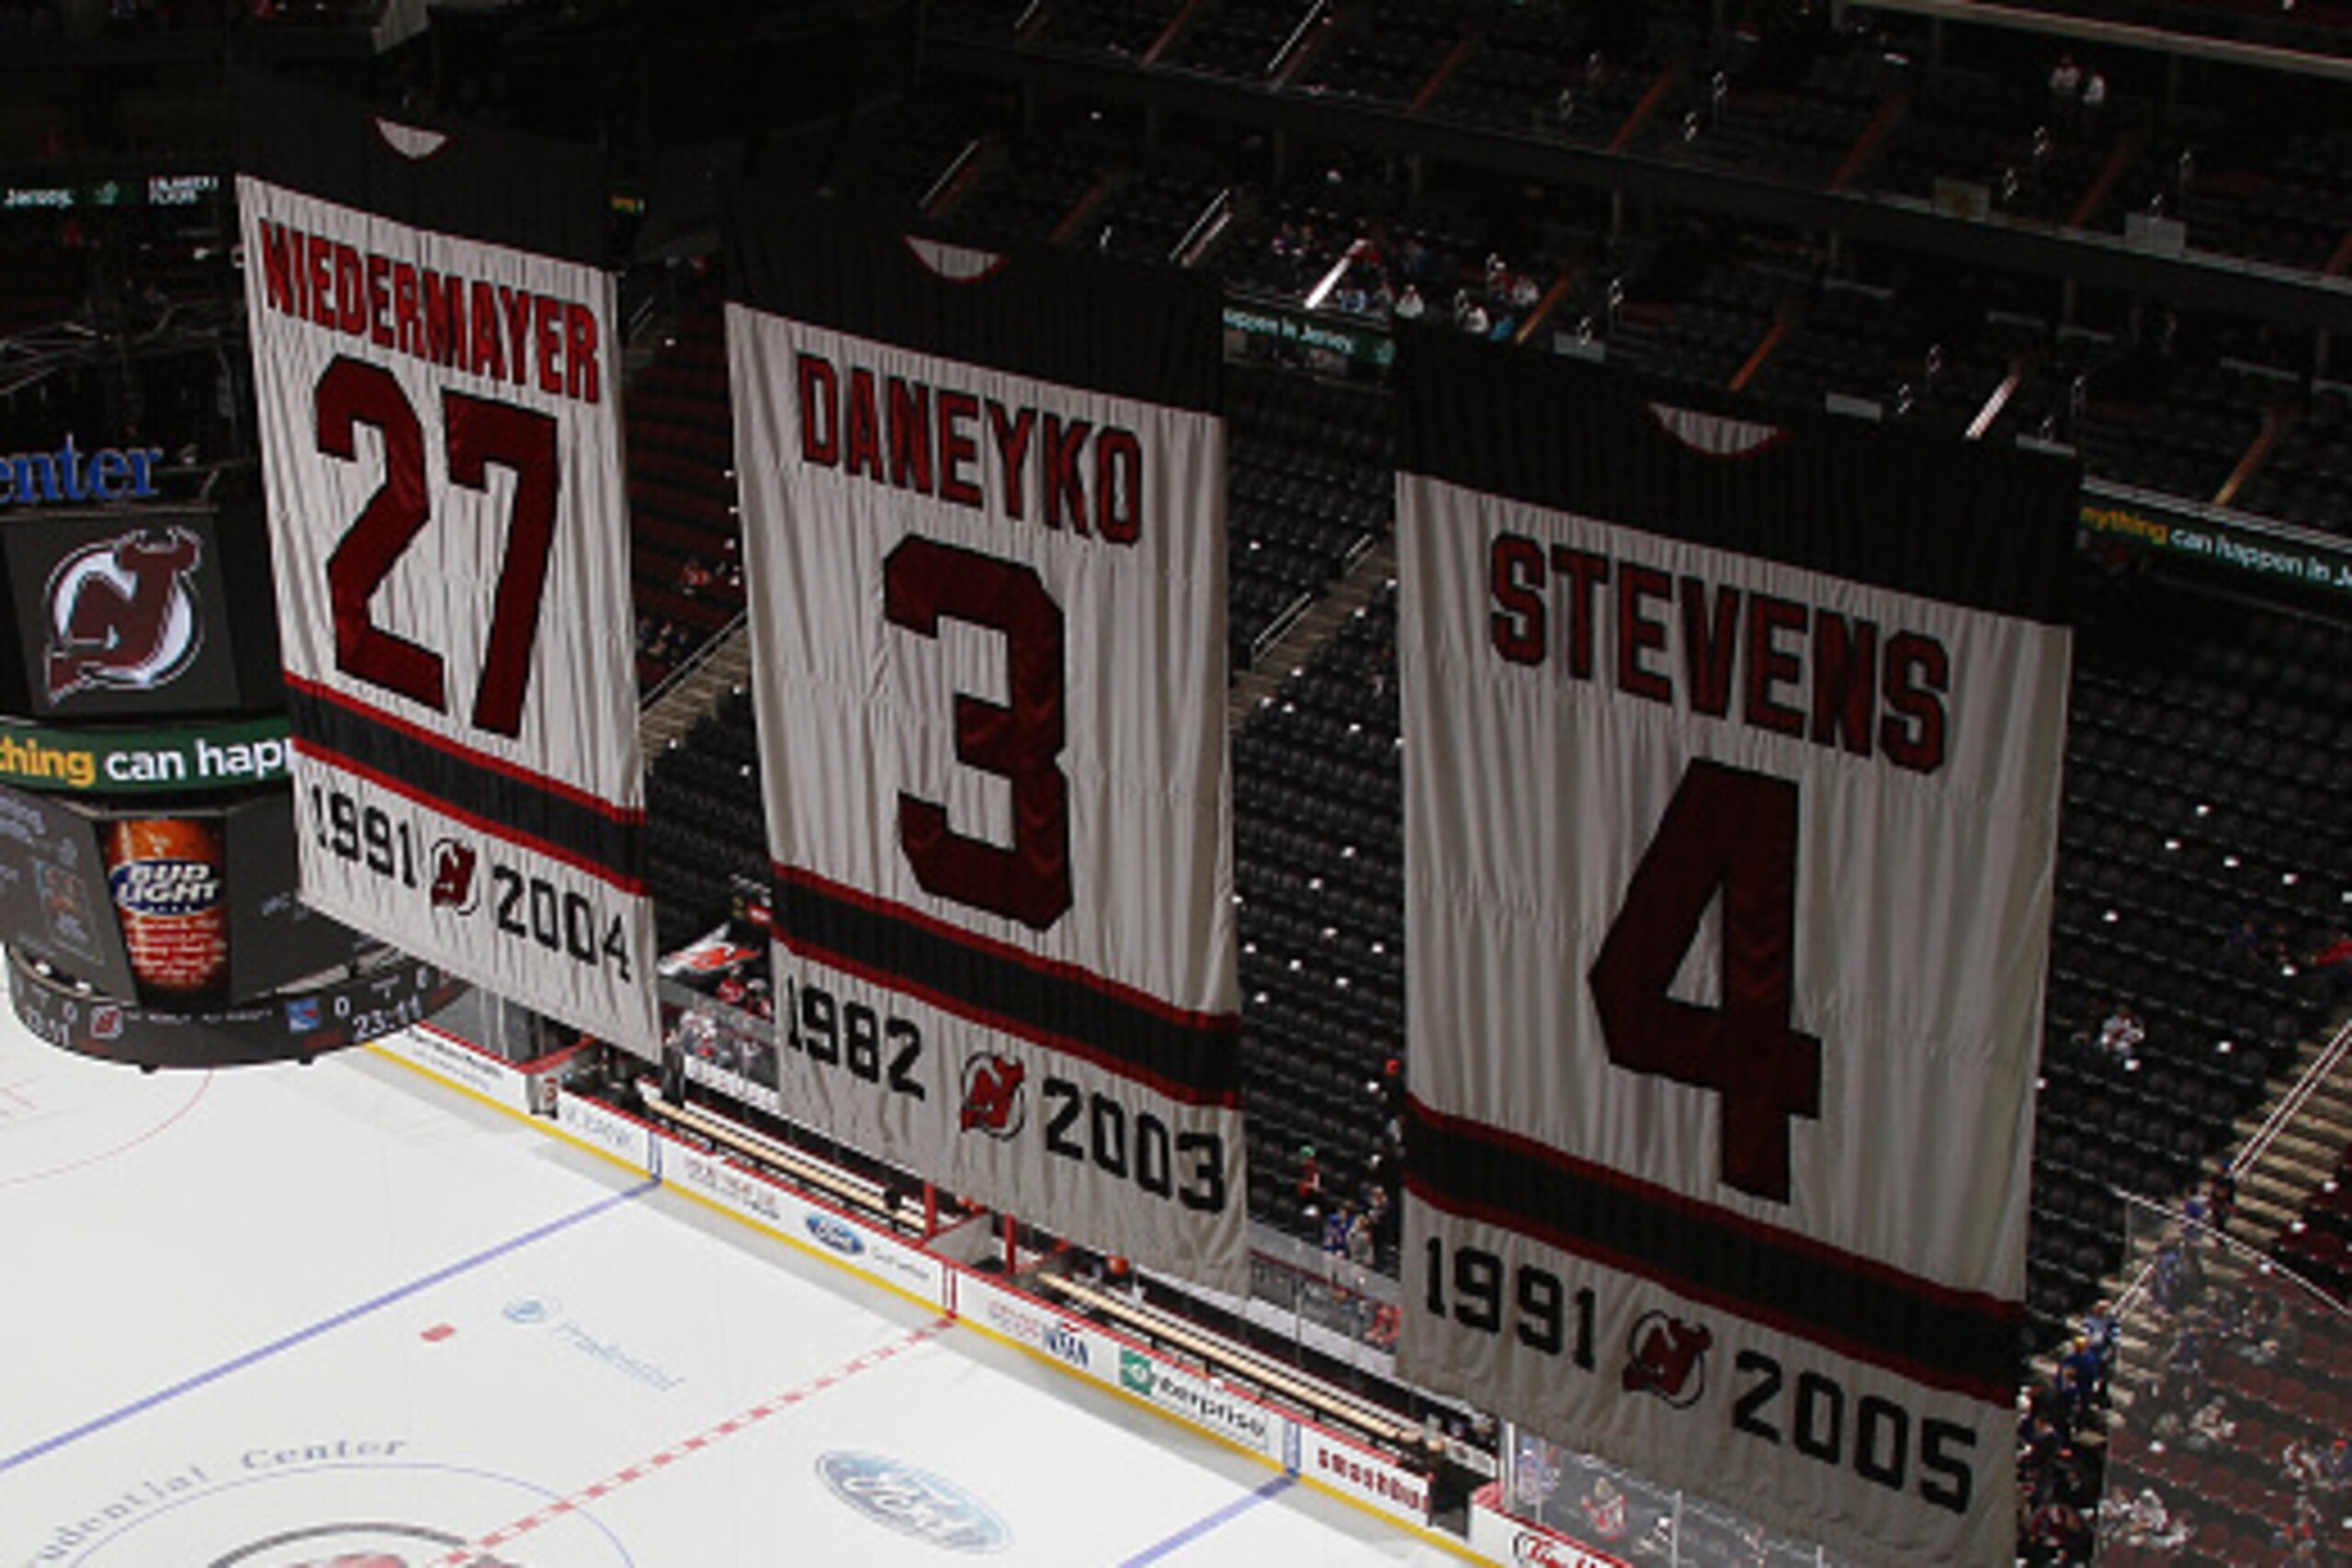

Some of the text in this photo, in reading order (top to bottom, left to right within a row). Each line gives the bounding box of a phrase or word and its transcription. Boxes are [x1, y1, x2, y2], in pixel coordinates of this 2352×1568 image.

[258, 216, 600, 404] NIEDERMAYER
[313, 353, 561, 740] 27
[797, 351, 1143, 548] DANEYKO
[883, 530, 1074, 934] 3
[1489, 530, 1950, 776] STEVENS
[104, 750, 187, 781] can
[117, 879, 220, 903] LIGHT
[129, 863, 210, 886] BUD
[311, 785, 632, 983] 1991 2004
[1587, 756, 1823, 1207] 4
[786, 976, 1227, 1213] 1982 2003
[242, 1440, 406, 1471] Center
[1424, 1236, 1979, 1515] 1991 2005
